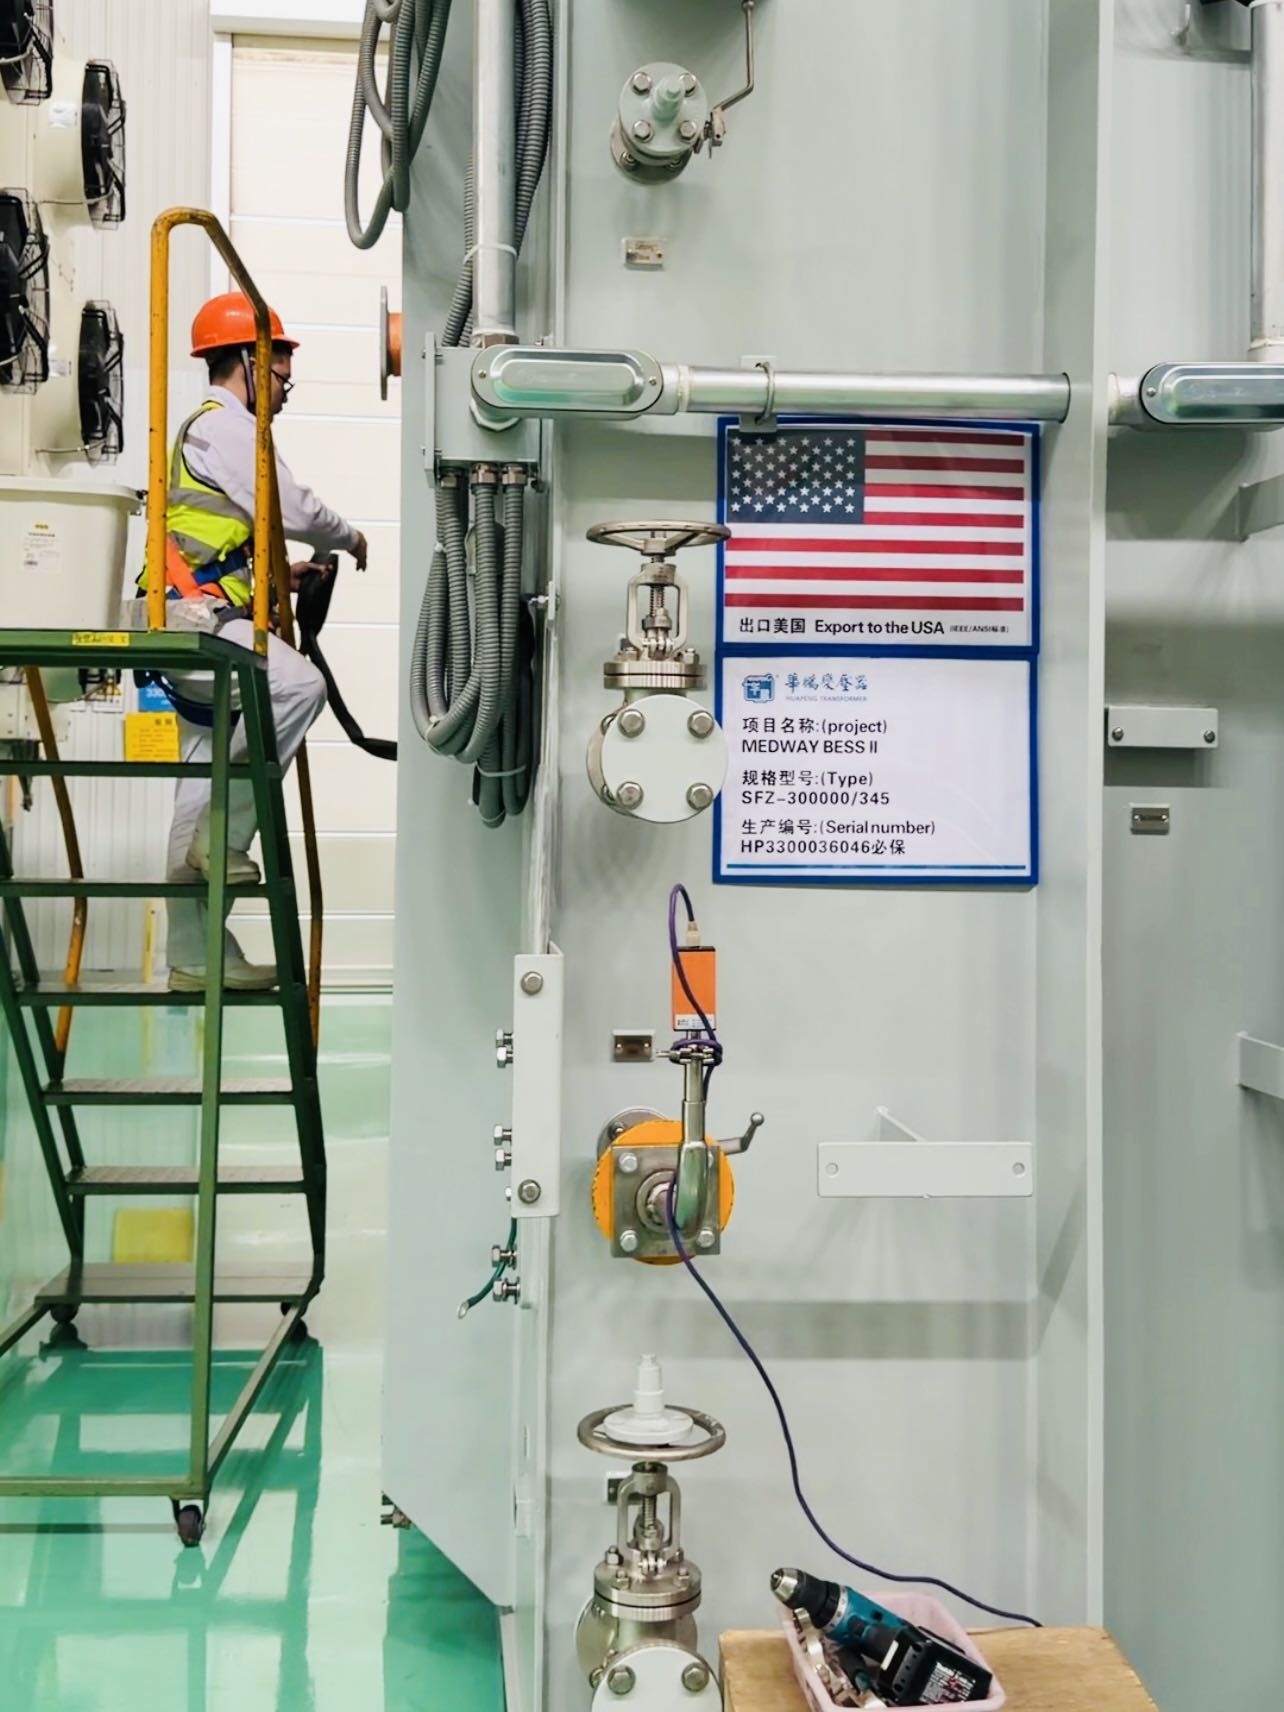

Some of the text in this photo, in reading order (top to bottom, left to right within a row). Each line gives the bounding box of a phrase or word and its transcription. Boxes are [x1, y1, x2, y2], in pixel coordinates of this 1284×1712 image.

[740, 618, 805, 633] 出口美国
[815, 620, 864, 635] Export
[867, 622, 882, 633] to
[885, 621, 908, 633] the
[912, 621, 944, 634] USA
[742, 740, 877, 753] MEDWAY BESS II
[742, 791, 889, 805] SFZ-300000/345
